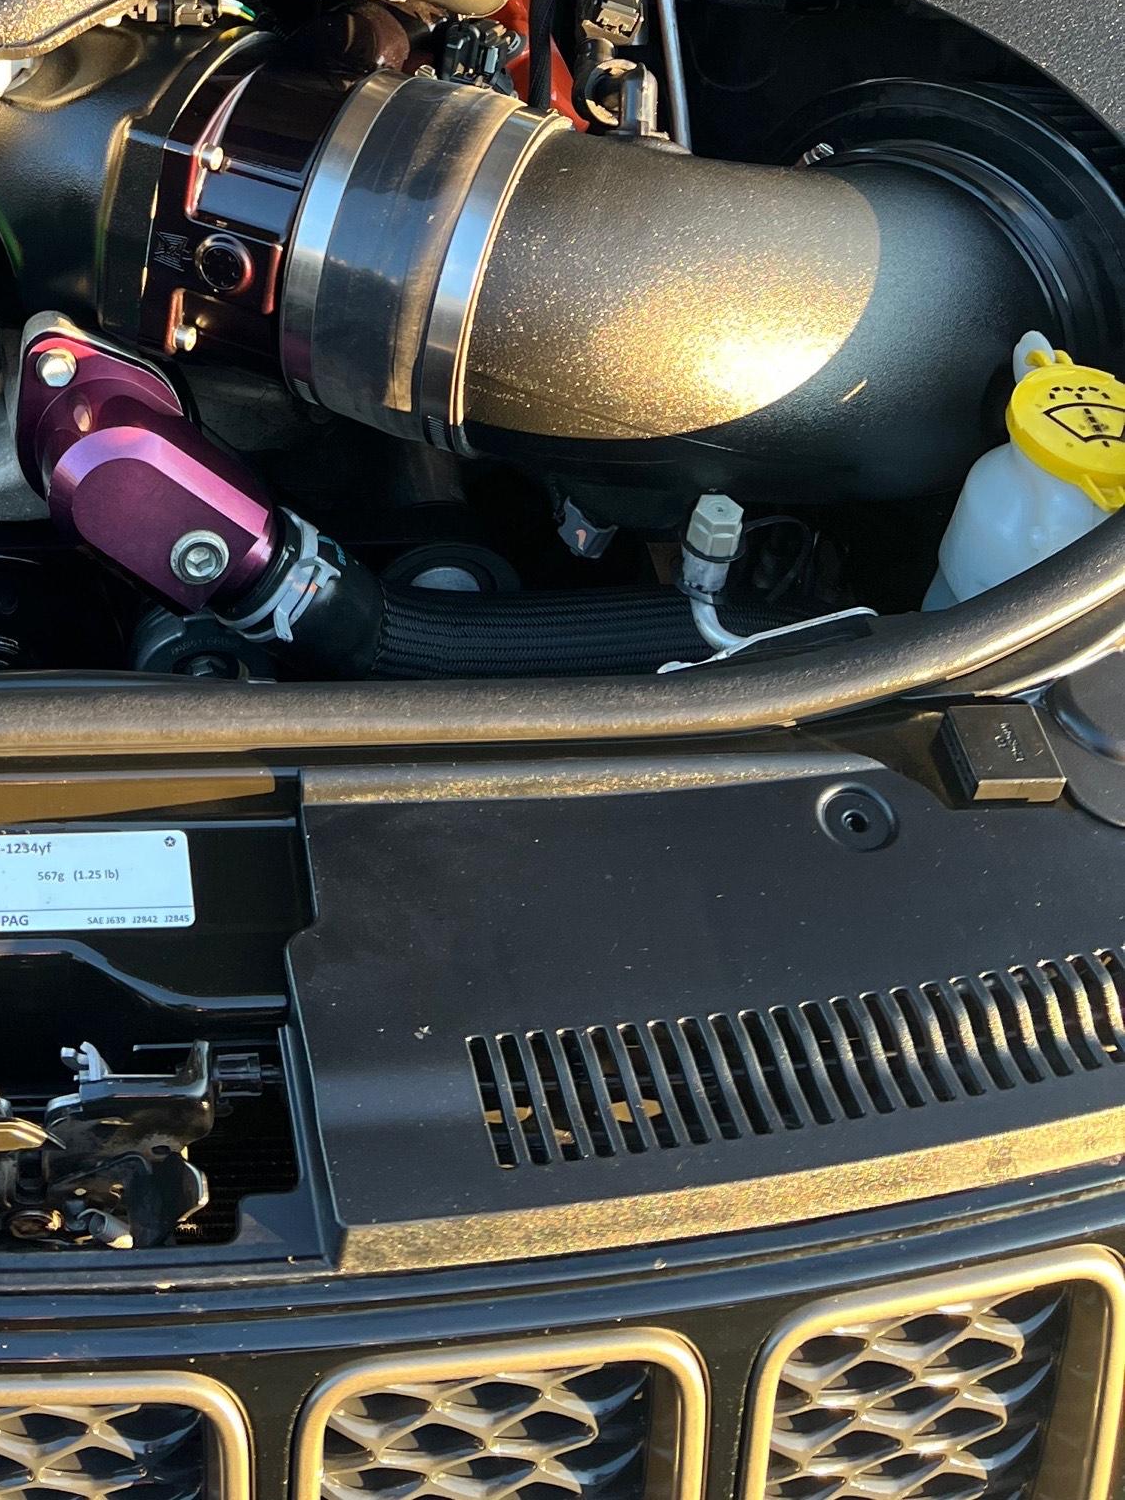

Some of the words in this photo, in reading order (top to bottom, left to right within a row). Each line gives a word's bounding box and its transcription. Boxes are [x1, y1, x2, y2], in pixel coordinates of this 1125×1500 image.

[37, 870, 65, 882] 567g
[73, 869, 102, 882] (1.25
[104, 868, 120, 881] lb)
[1, 914, 29, 927] PAG
[87, 916, 104, 925] SAE
[106, 916, 126, 925] J639
[132, 915, 158, 925] J2842
[164, 914, 190, 924] J2845
